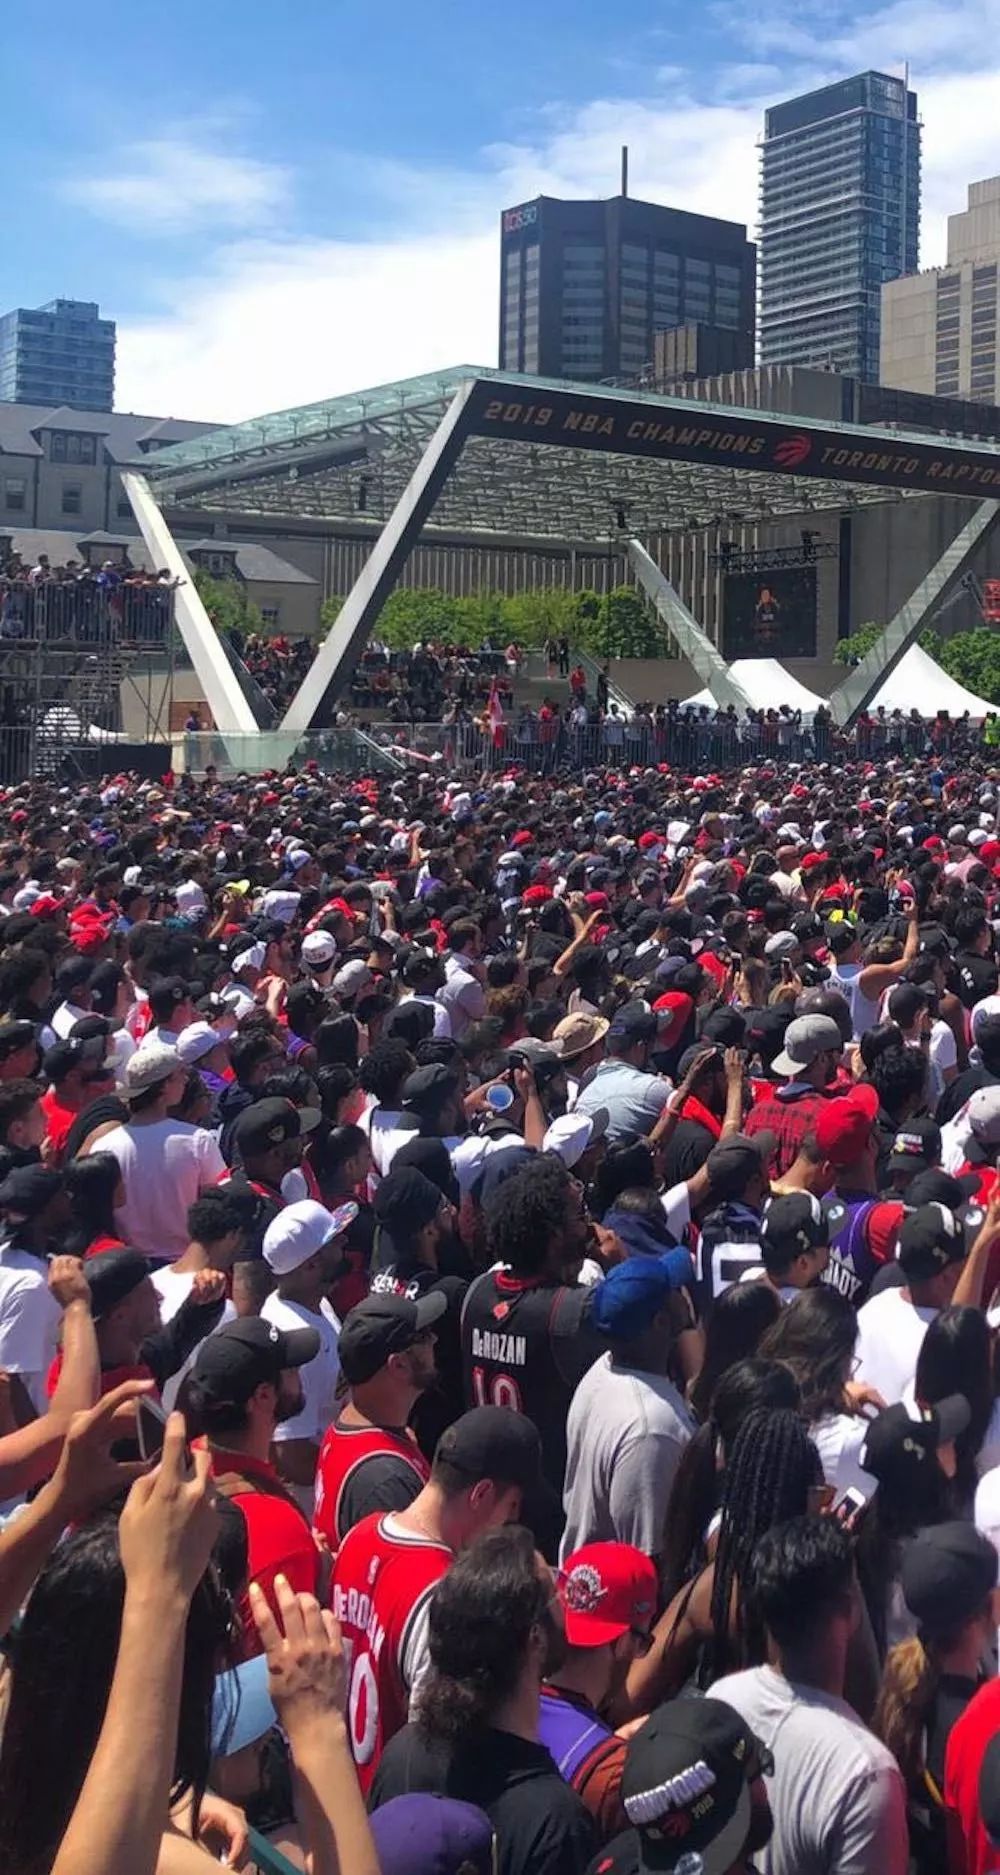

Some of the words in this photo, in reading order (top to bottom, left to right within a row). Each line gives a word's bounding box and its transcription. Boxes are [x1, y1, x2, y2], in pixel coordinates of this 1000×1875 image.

[483, 401, 552, 426] 2019
[563, 411, 613, 435] NBA
[627, 420, 766, 454] CHAMPIONS
[820, 448, 920, 474] TORONTO
[472, 1328, 526, 1365] DeROZAN
